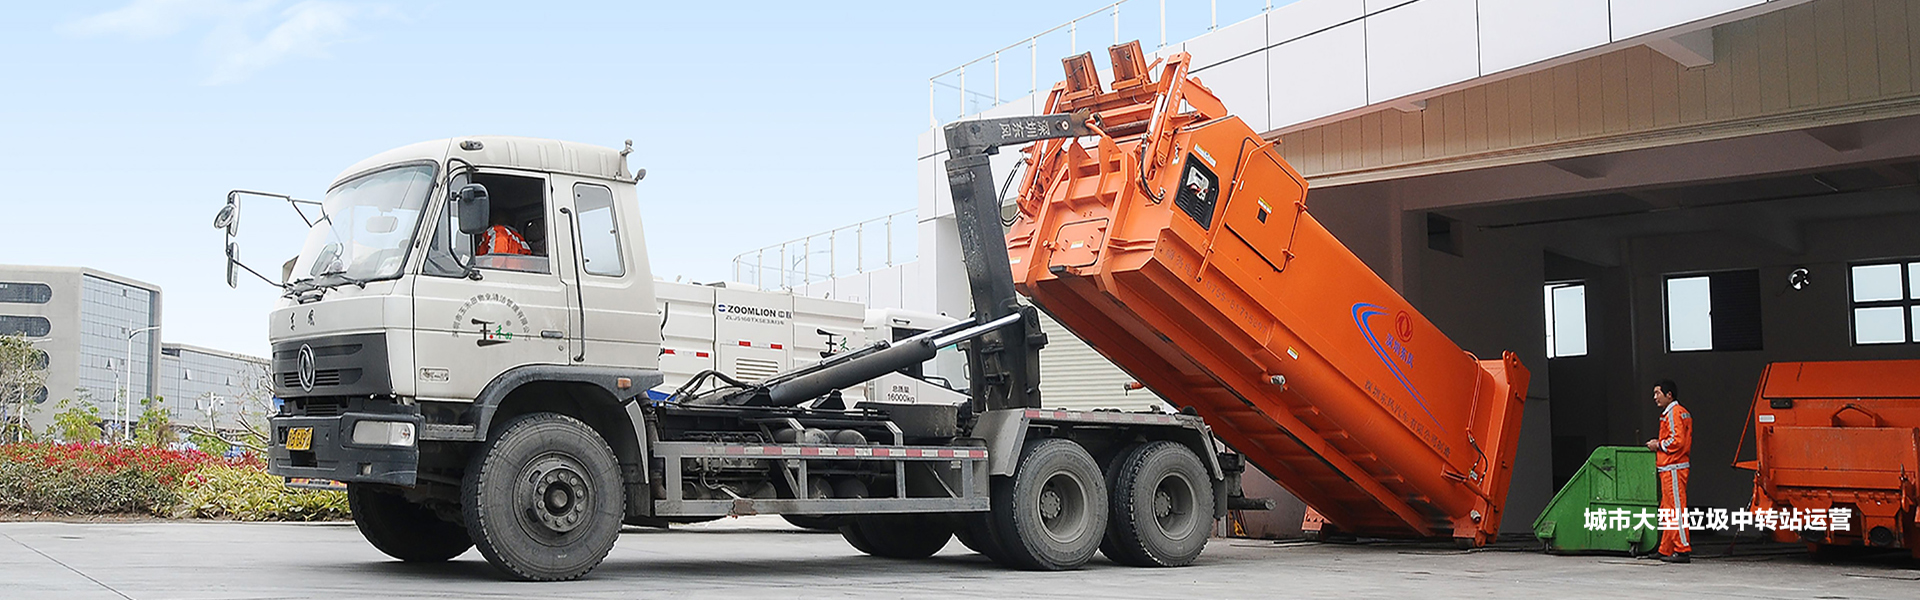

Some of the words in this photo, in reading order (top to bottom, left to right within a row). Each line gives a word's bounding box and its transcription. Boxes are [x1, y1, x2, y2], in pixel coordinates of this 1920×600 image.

[999, 118, 1051, 140] 深圳东风
[727, 304, 776, 318] ZOOMLION
